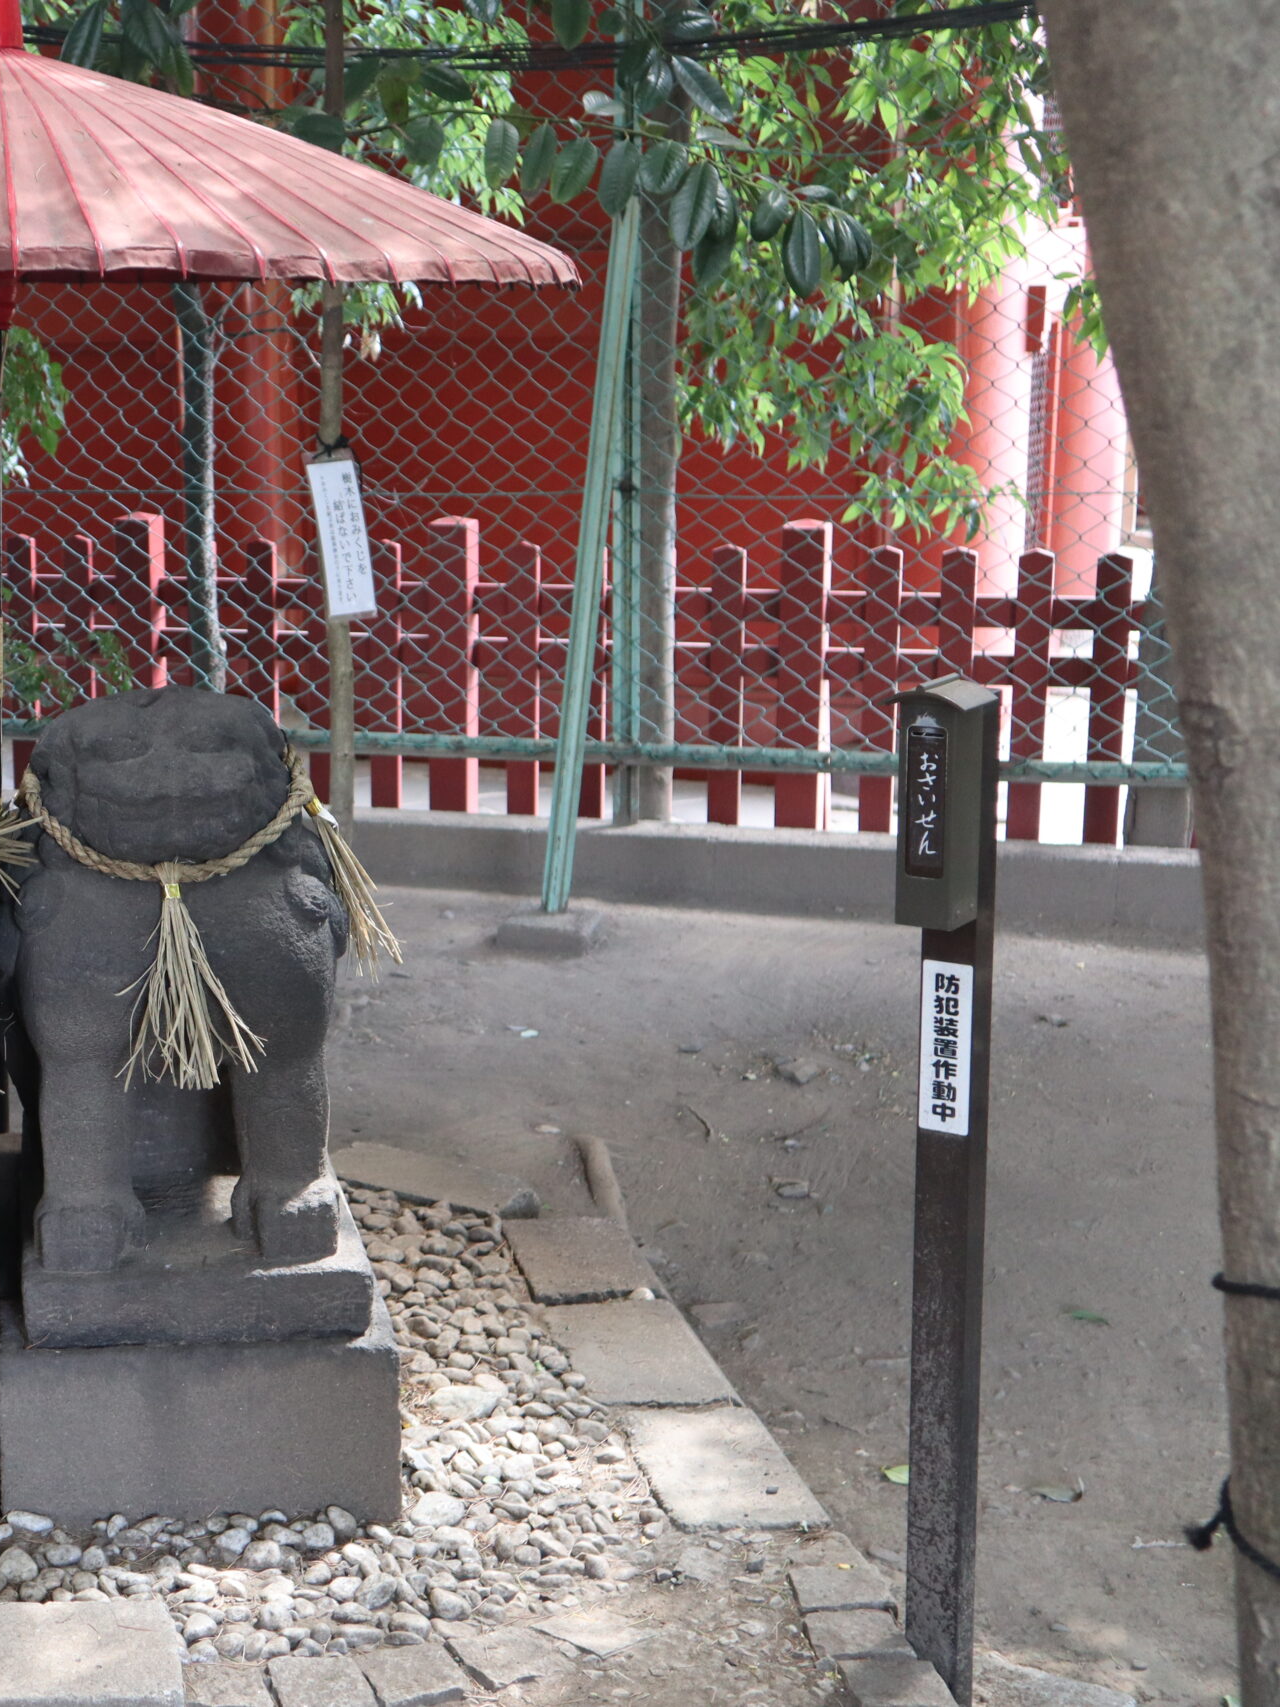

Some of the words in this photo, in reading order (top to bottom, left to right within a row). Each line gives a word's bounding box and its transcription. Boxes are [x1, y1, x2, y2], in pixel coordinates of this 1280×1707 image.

[914, 751, 939, 856] おさいせん
[931, 972, 961, 1123] 防犯装置作動中
